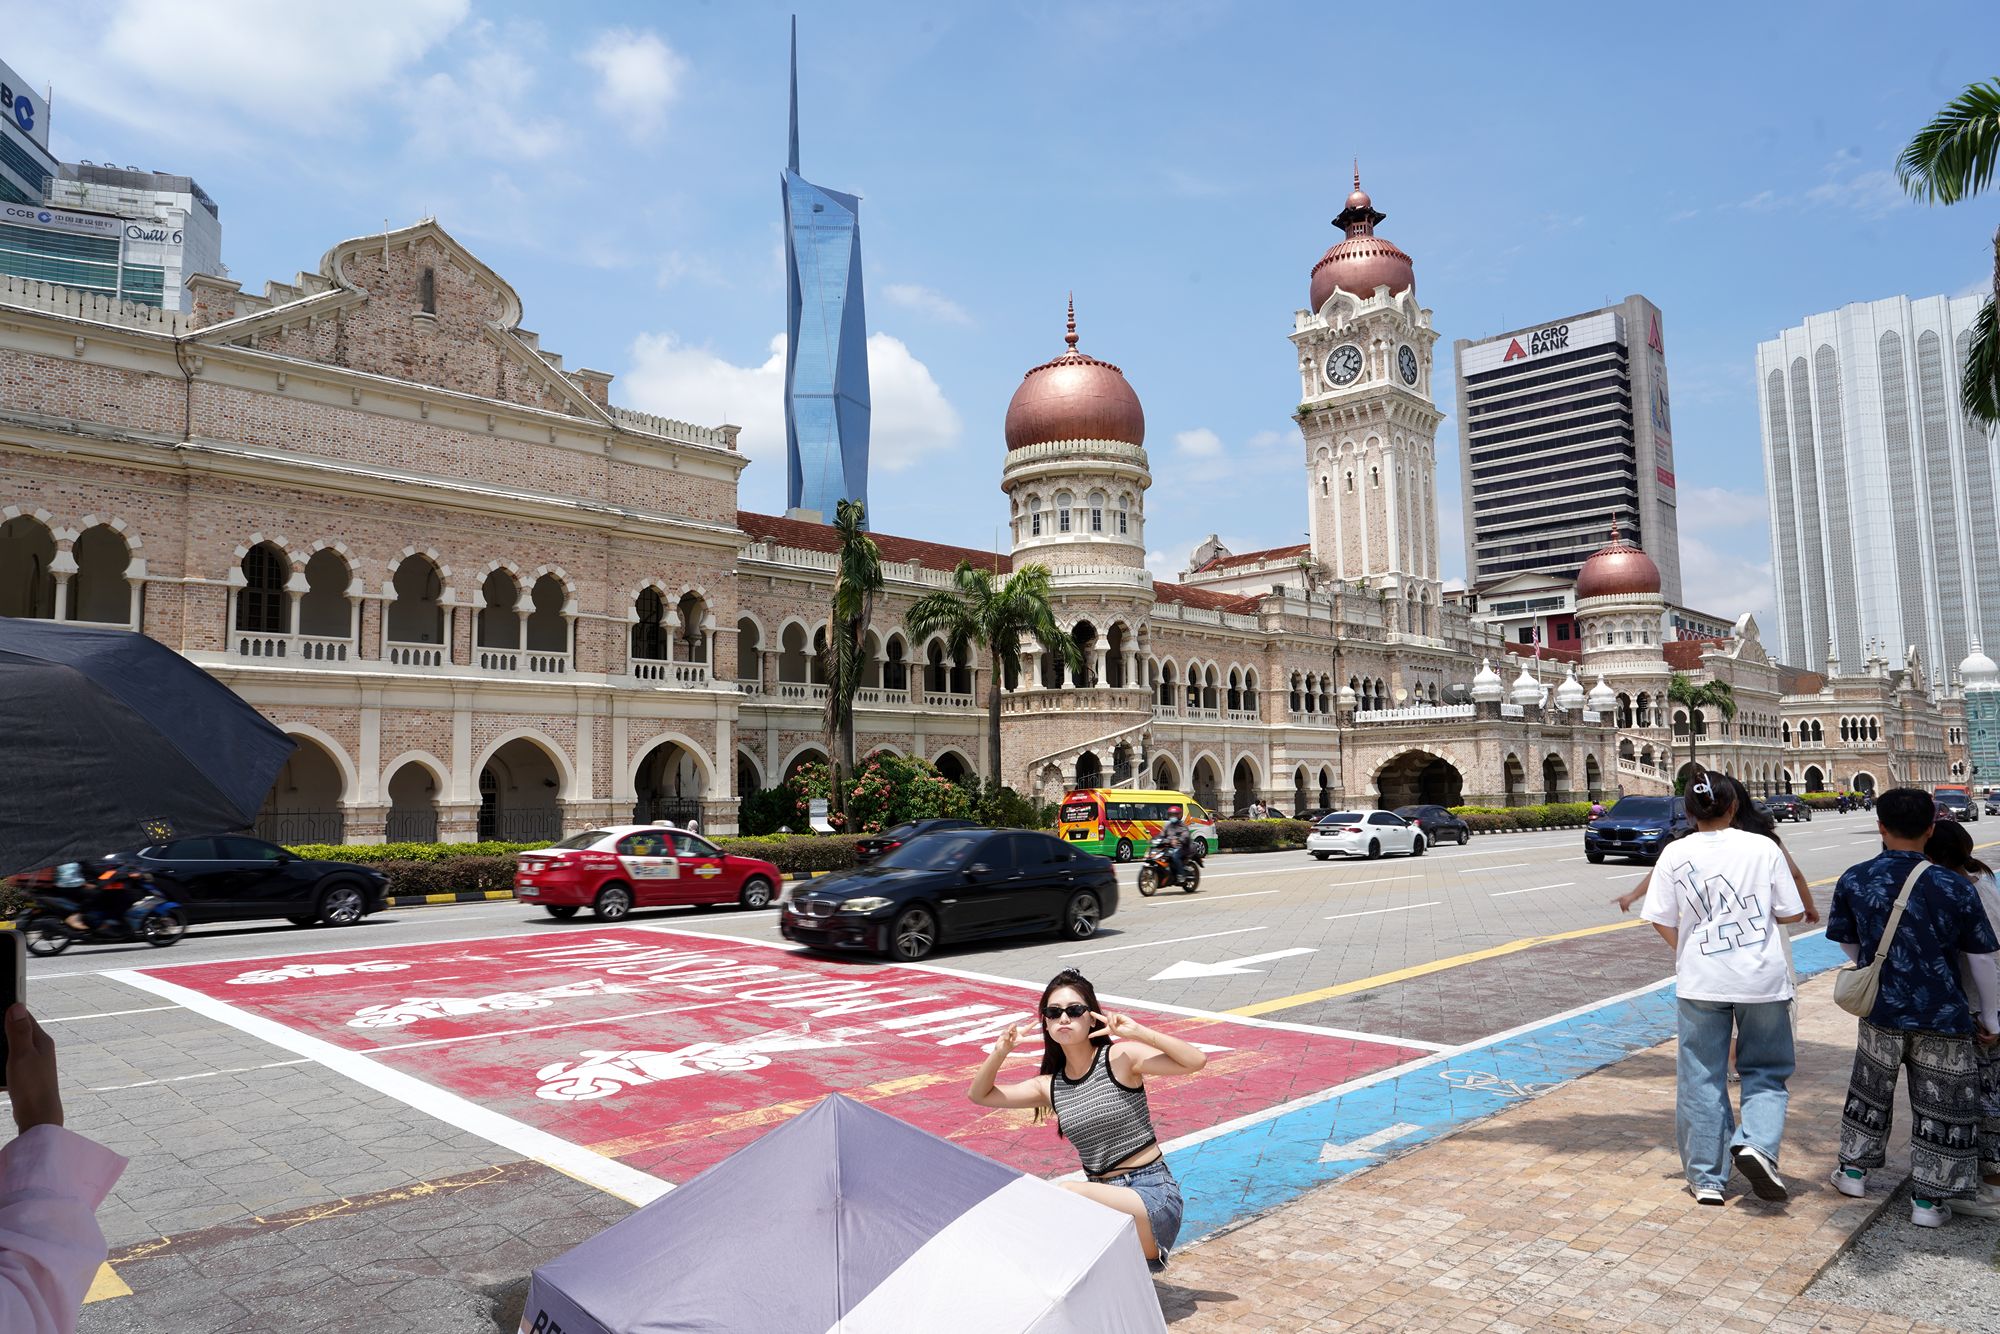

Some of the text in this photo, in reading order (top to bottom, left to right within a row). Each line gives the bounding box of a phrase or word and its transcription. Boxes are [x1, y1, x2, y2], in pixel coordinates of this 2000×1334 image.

[6, 208, 35, 219] CCB
[127, 225, 182, 243] Quill 6
[1531, 325, 1569, 343] AGRO
[1531, 336, 1569, 355] BANK
